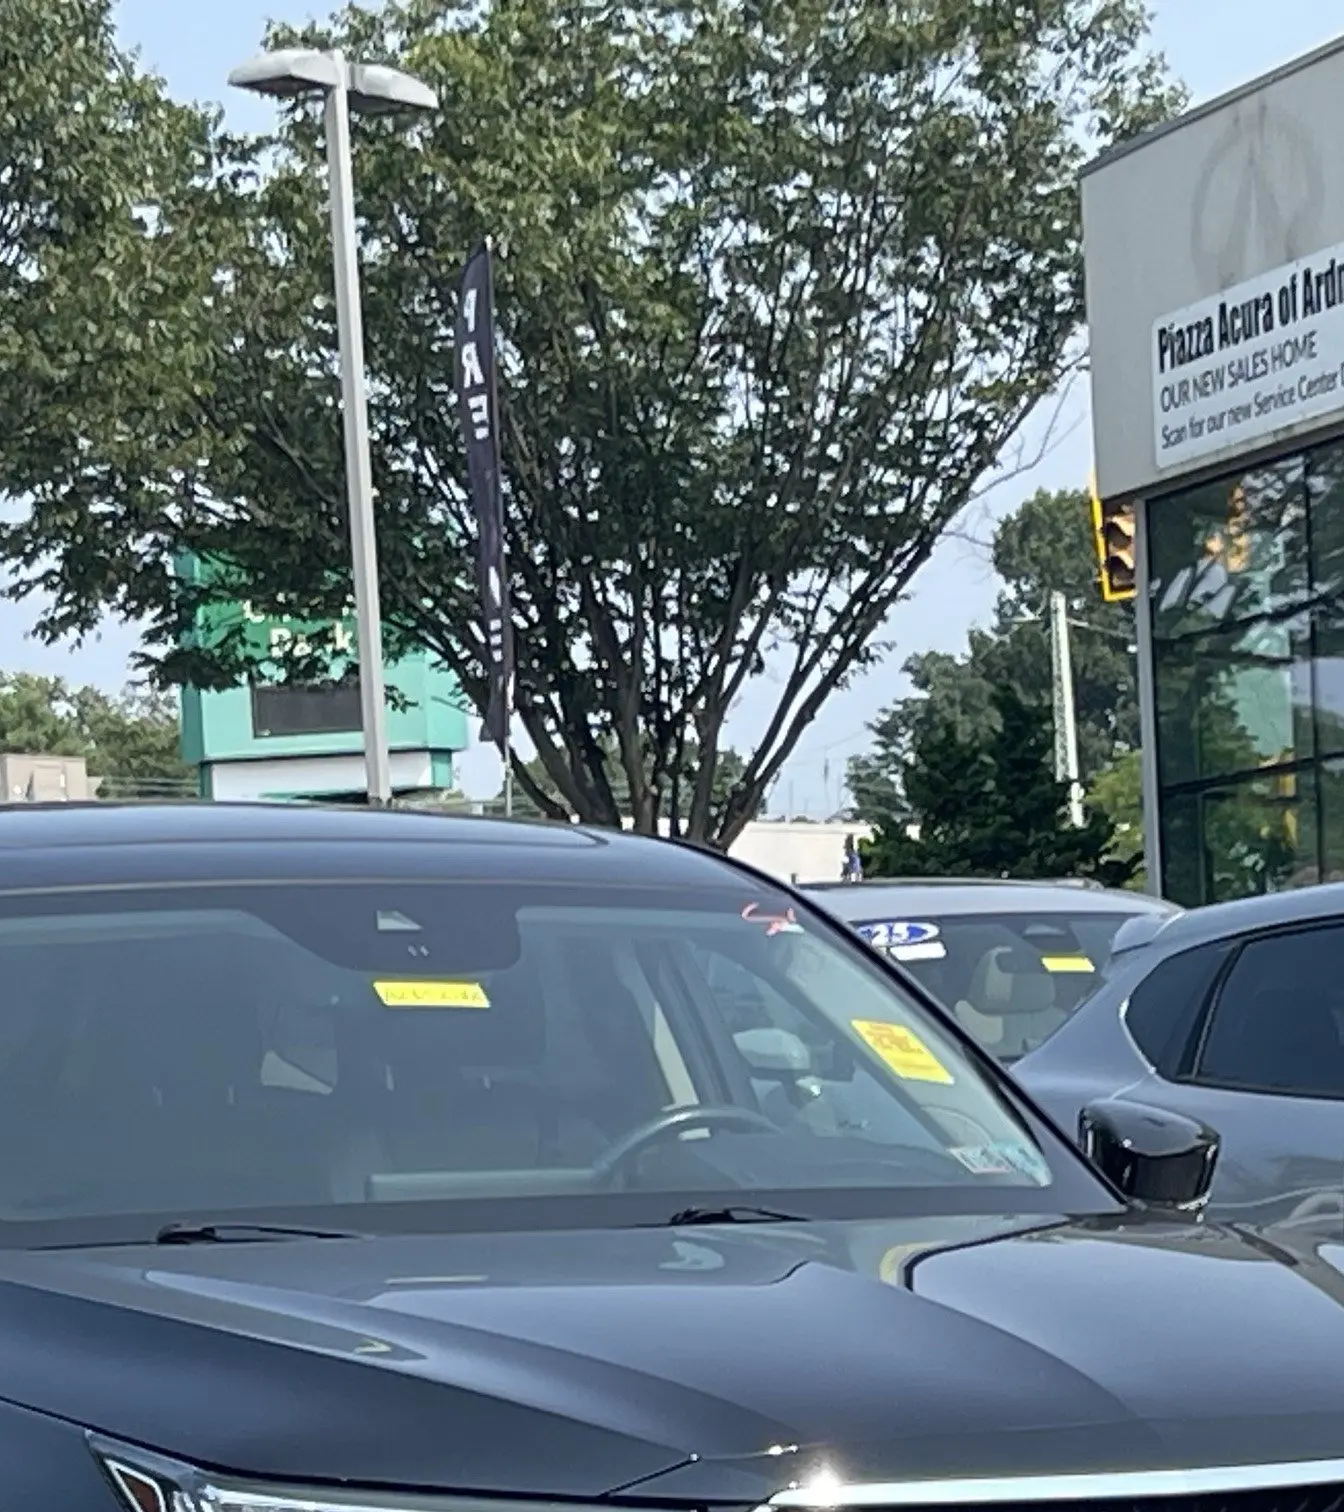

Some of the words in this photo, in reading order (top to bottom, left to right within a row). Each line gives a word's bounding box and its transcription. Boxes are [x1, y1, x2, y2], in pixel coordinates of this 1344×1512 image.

[1157, 322, 1215, 374] Piazza
[1218, 302, 1274, 350] Acura
[1278, 272, 1298, 327] of
[1159, 379, 1191, 412] OUR
[1193, 364, 1225, 399] NEW
[1227, 349, 1268, 389] SALES
[1271, 329, 1317, 373] HOME
[1161, 424, 1188, 449] Scan
[1189, 414, 1205, 439] for
[1207, 410, 1227, 433] our
[1228, 403, 1252, 426] new
[1254, 383, 1297, 418] Service
[1298, 369, 1339, 401] Center
[270, 622, 353, 658] Bak
